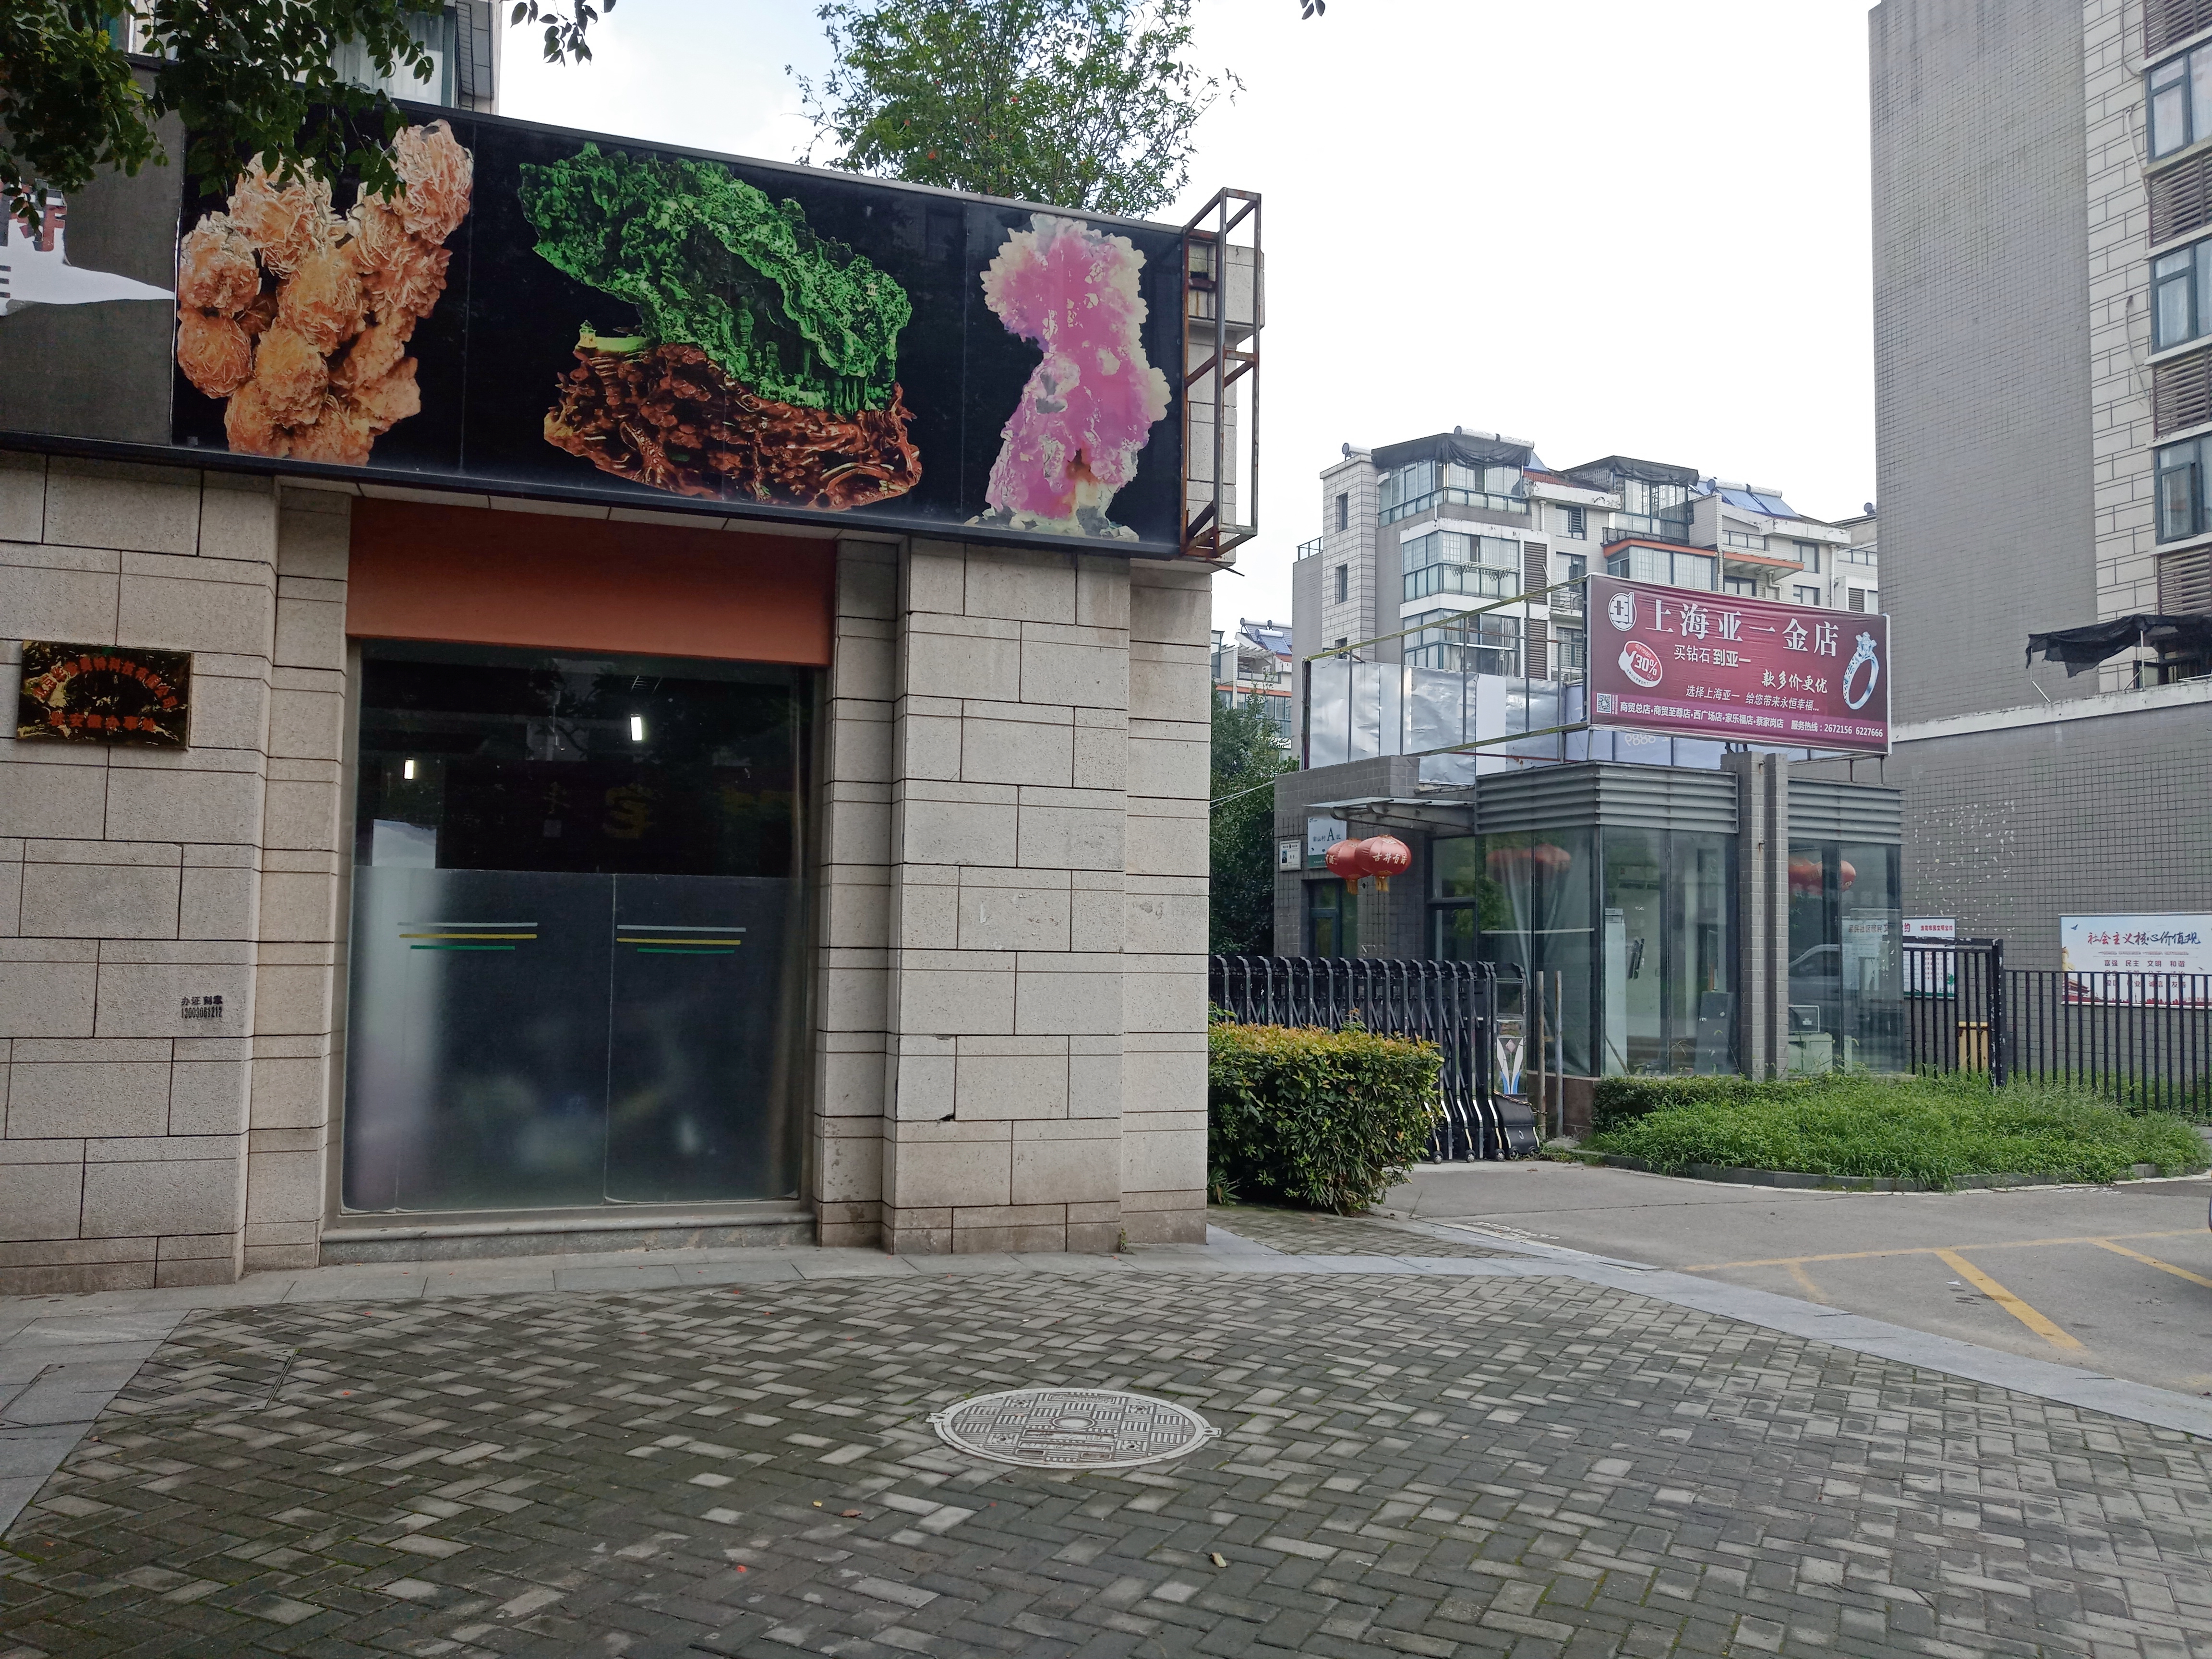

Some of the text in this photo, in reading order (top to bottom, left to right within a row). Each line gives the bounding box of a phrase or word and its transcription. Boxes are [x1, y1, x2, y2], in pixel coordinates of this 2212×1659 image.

[1645, 599, 1839, 657] 上海亚一金店
[1634, 654, 1658, 676] 30%
[1674, 644, 1751, 668] 买钻石到亚一
[1761, 669, 1828, 694] 款多价更优
[1685, 685, 1740, 701] 选择上海亚一
[1855, 727, 1883, 738] 6227666
[2088, 931, 2201, 946] 社会主义核心价值观
